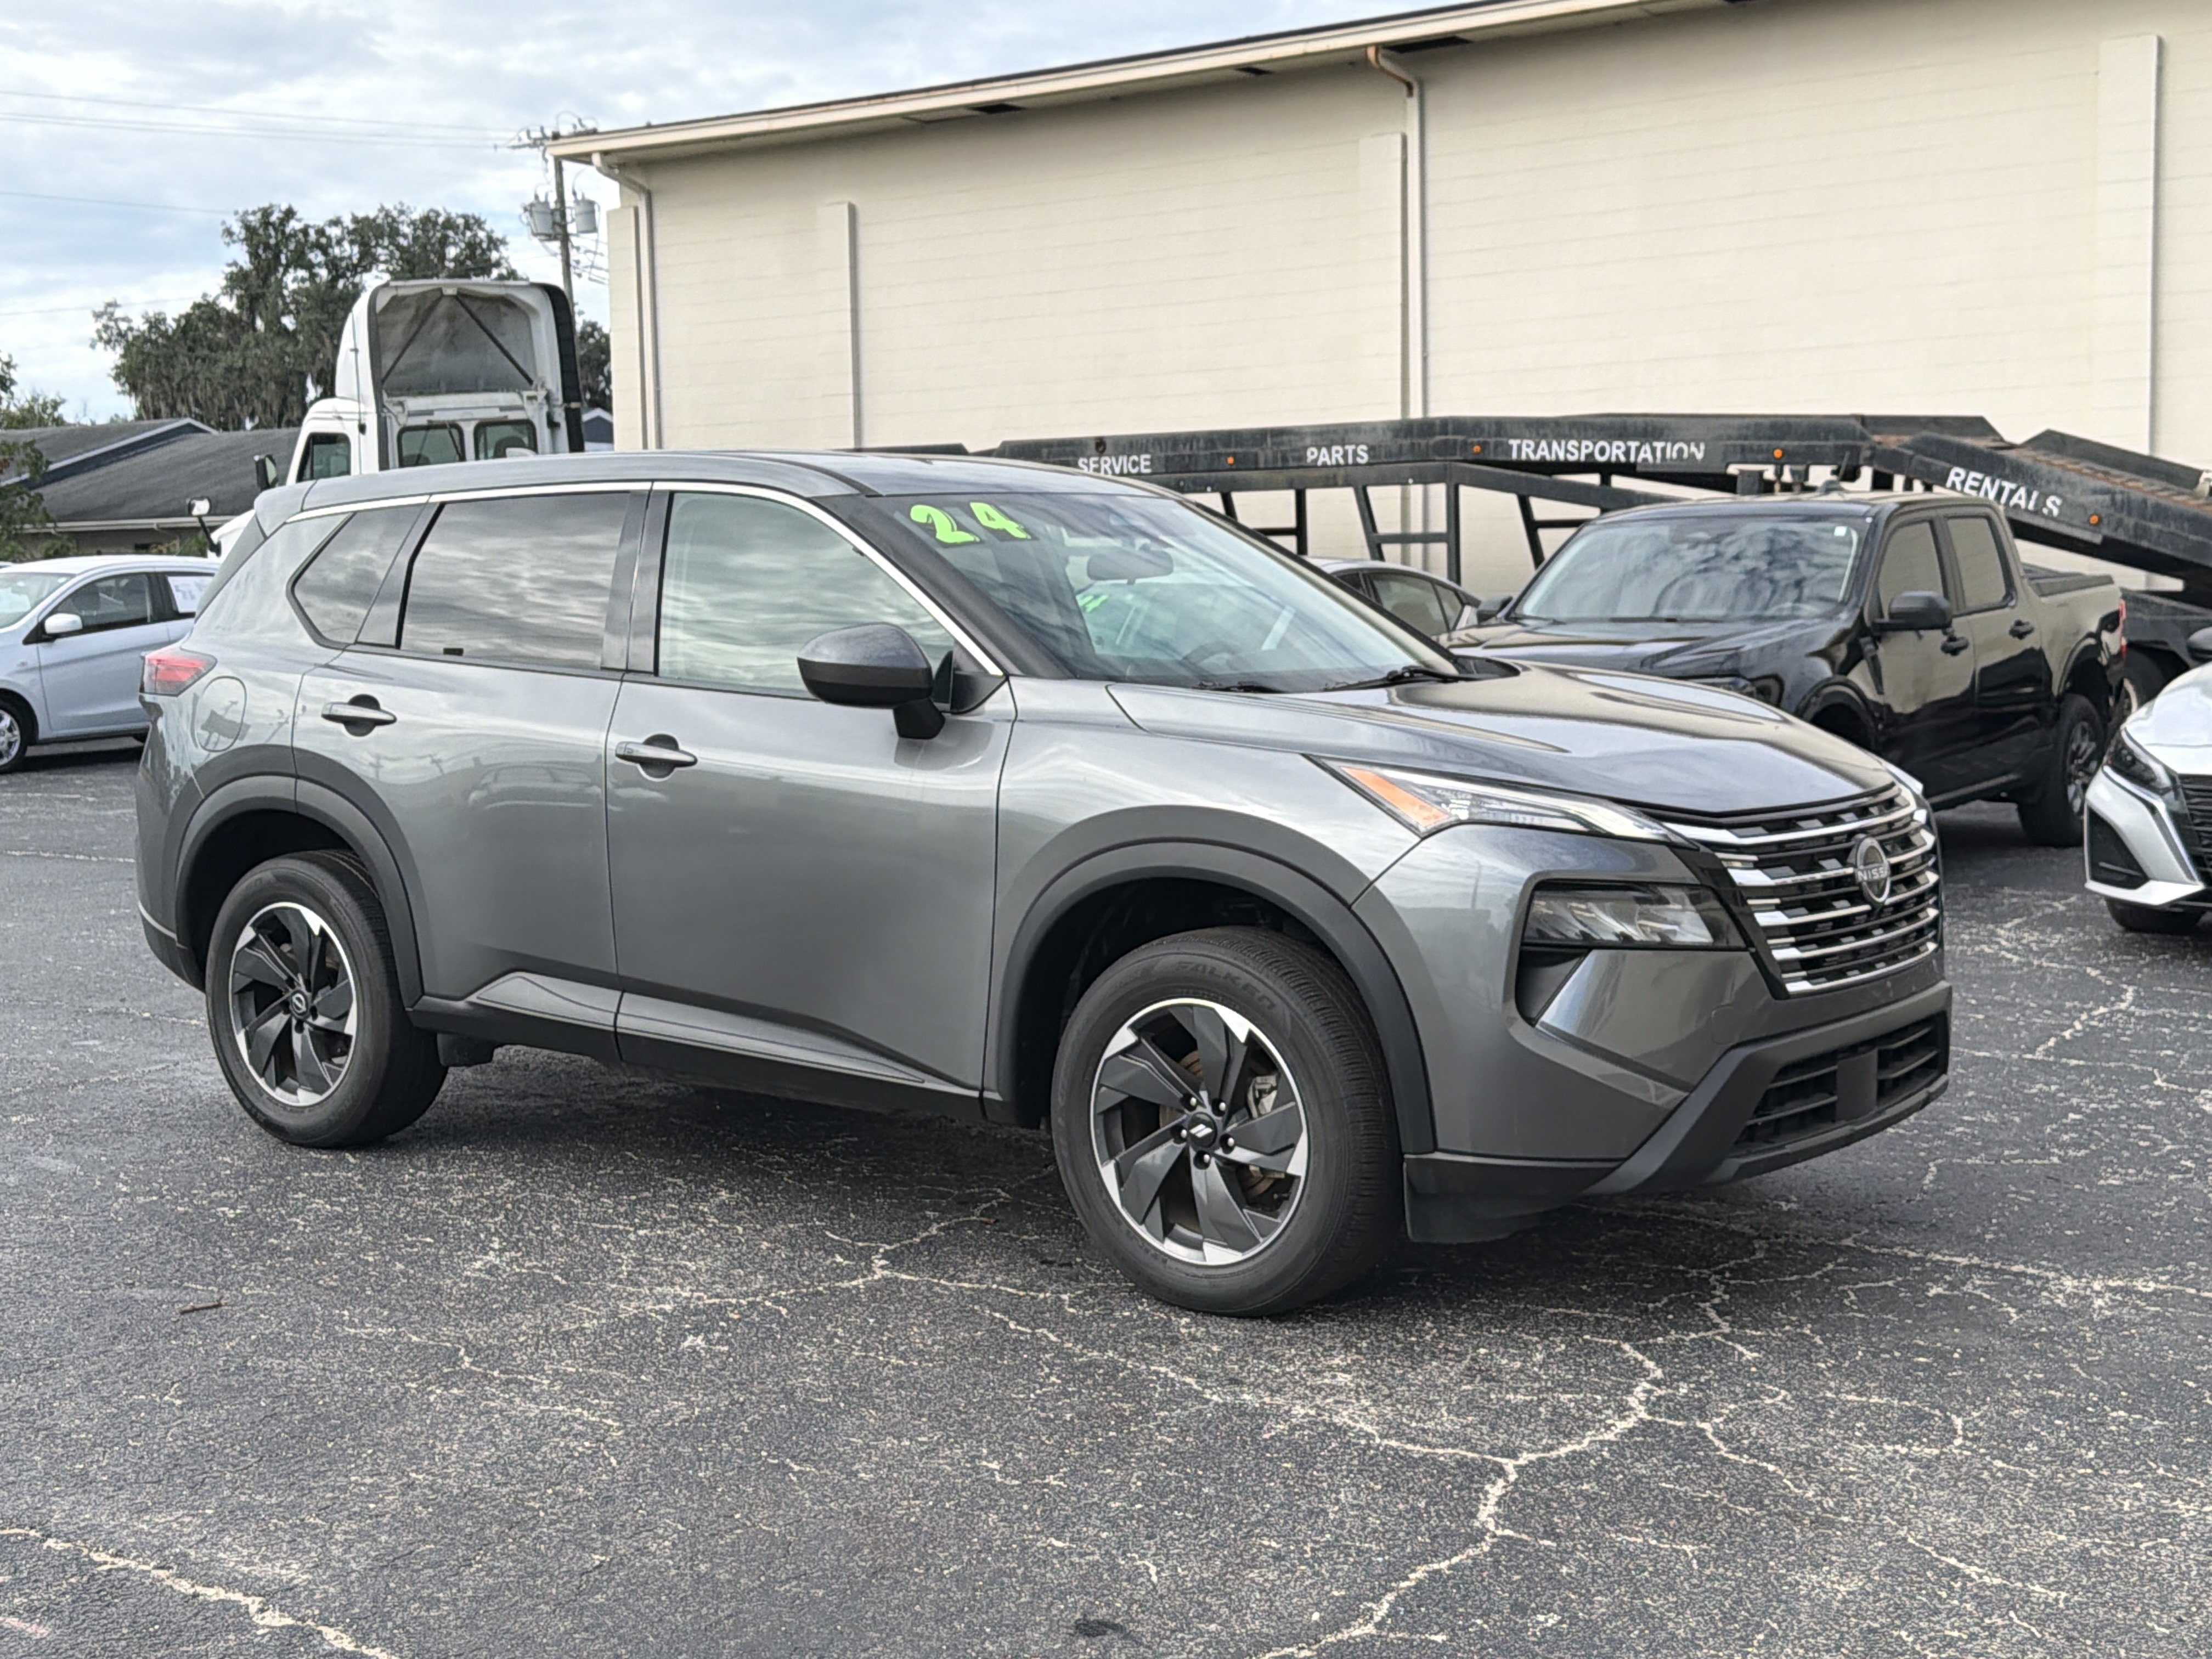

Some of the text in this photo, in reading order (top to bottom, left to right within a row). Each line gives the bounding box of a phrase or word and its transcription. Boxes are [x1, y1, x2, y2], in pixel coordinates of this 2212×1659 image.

[1306, 444, 1369, 466] PARTS
[1508, 439, 1706, 463] TRANSPORTATION
[1077, 454, 1152, 475] SERVICE
[1945, 466, 2063, 517] RENTALS
[910, 502, 1032, 543] 24
